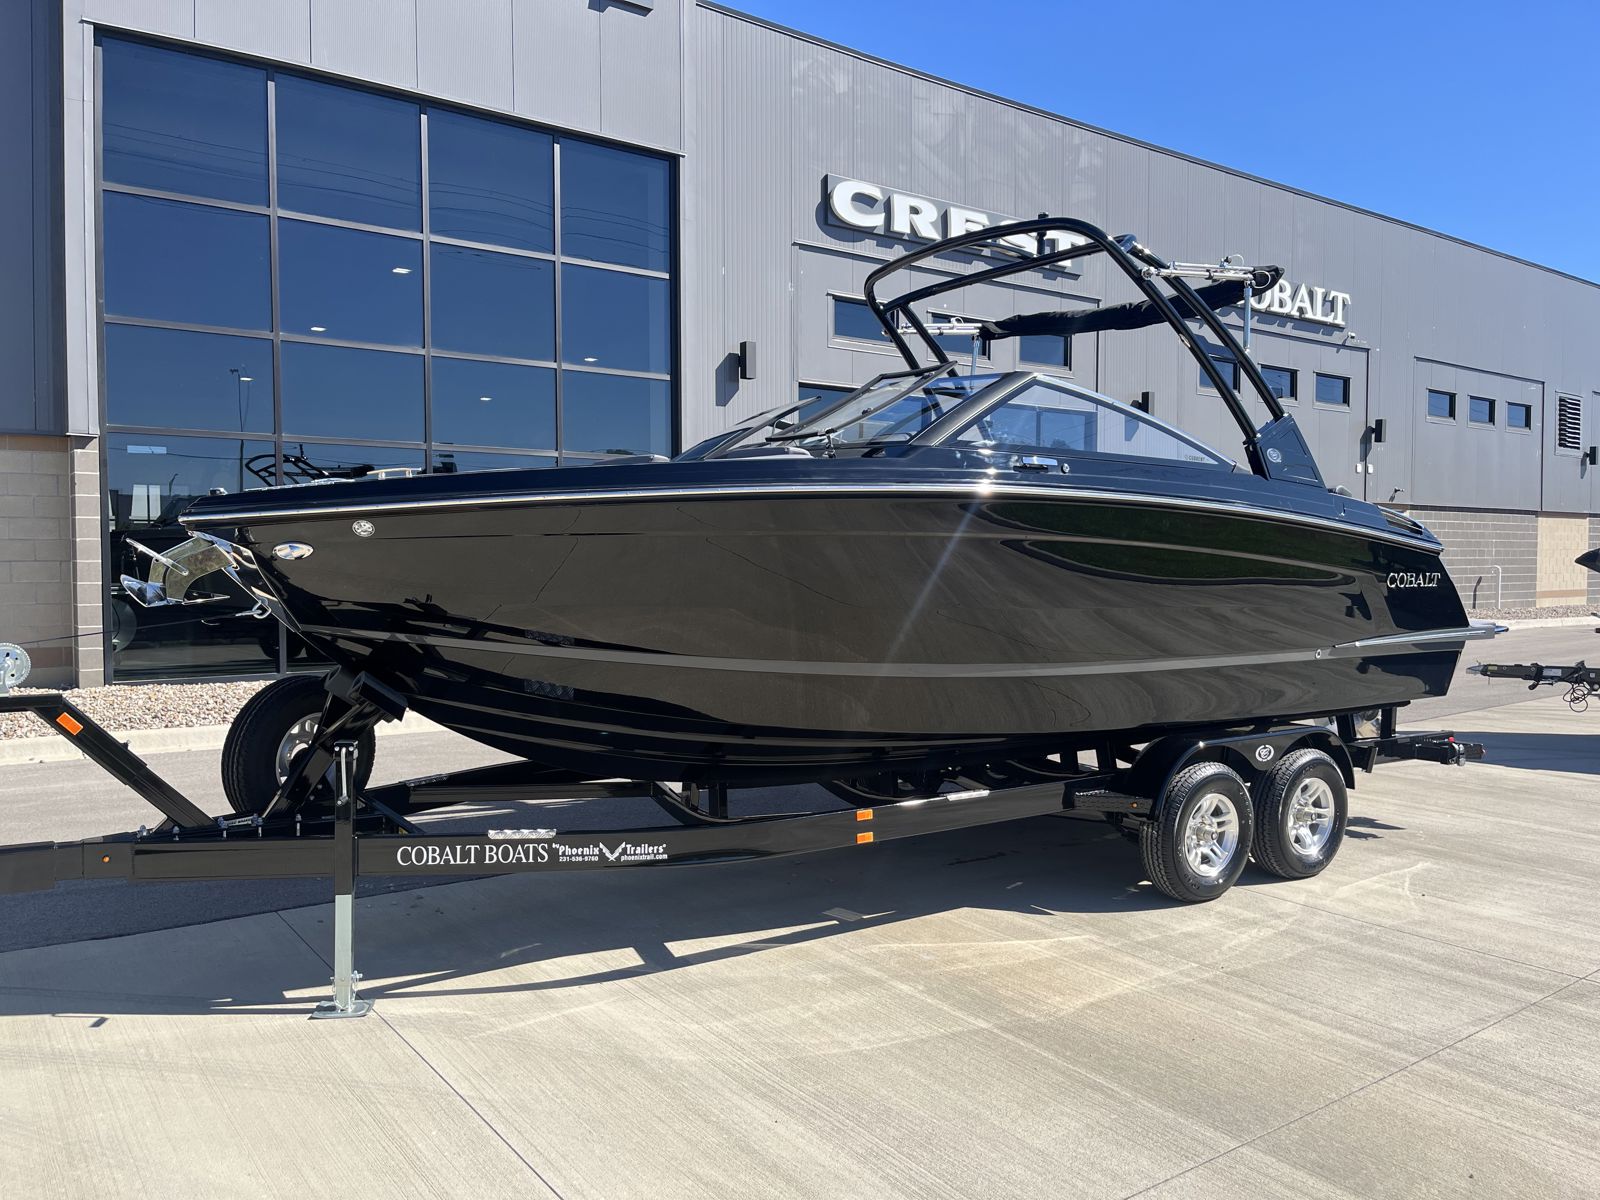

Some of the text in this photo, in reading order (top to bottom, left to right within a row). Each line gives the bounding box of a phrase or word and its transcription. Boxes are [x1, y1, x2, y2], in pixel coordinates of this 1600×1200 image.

[1386, 572, 1441, 588] COBALT
[396, 845, 480, 866] COBALT
[483, 843, 549, 864] BOATS
[558, 844, 600, 856] Phoenix
